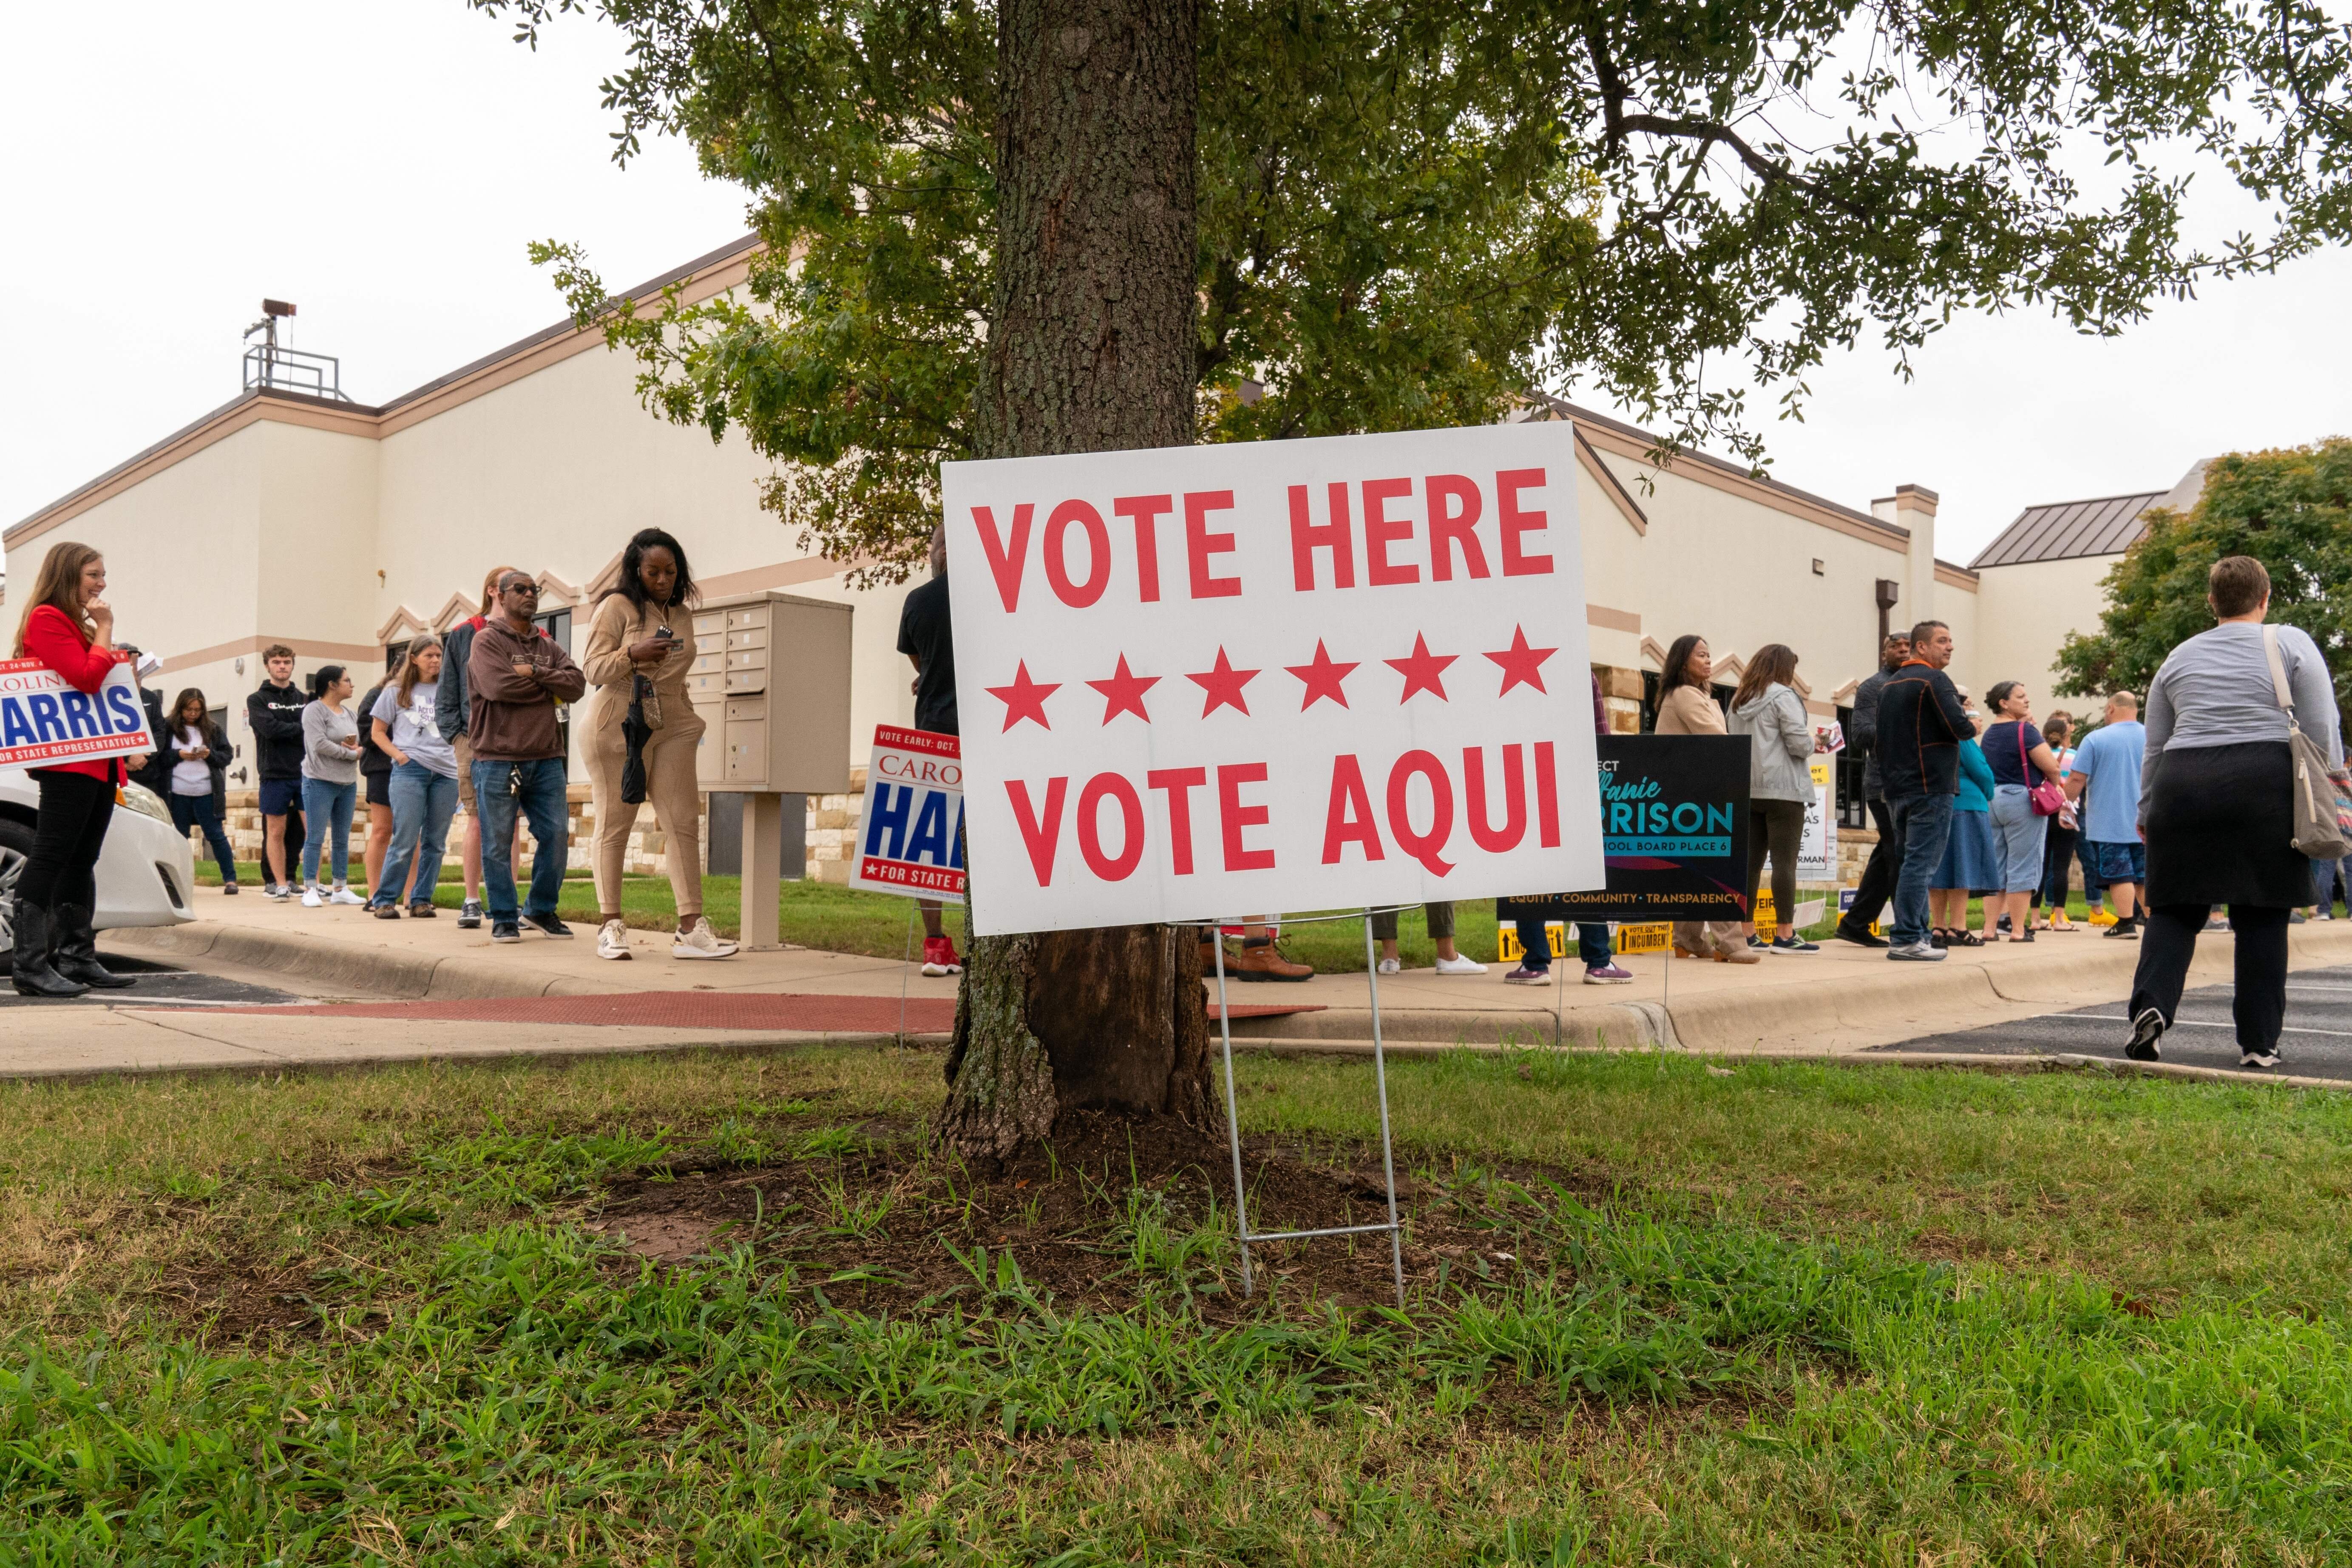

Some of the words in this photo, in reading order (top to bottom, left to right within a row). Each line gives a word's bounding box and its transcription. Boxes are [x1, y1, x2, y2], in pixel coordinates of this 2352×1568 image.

[971, 491, 1242, 613] VOTE
[1288, 468, 1554, 591] HERE
[0, 673, 71, 692] OLIN
[0, 686, 141, 747] ARRIS
[418, 705, 435, 714] Acro
[17, 748, 48, 759] STATE
[51, 736, 136, 754] REPRESENTATIVE
[880, 731, 901, 743] VOTE
[904, 735, 933, 748] EARLY:
[937, 741, 955, 752] OCT.
[1005, 763, 1275, 887] VOTE
[1322, 741, 1560, 877] AQUI
[1637, 842, 1676, 851] BOARD
[1680, 842, 1716, 851] PLACE
[1720, 842, 1727, 851] 6
[880, 865, 905, 881] FOR
[911, 870, 951, 888] STATE
[1509, 894, 1554, 904] EQUITY
[1562, 894, 1637, 904] COMMUNITY
[1647, 893, 1740, 904] TRANSPARENCY
[1645, 925, 1656, 933] OUT
